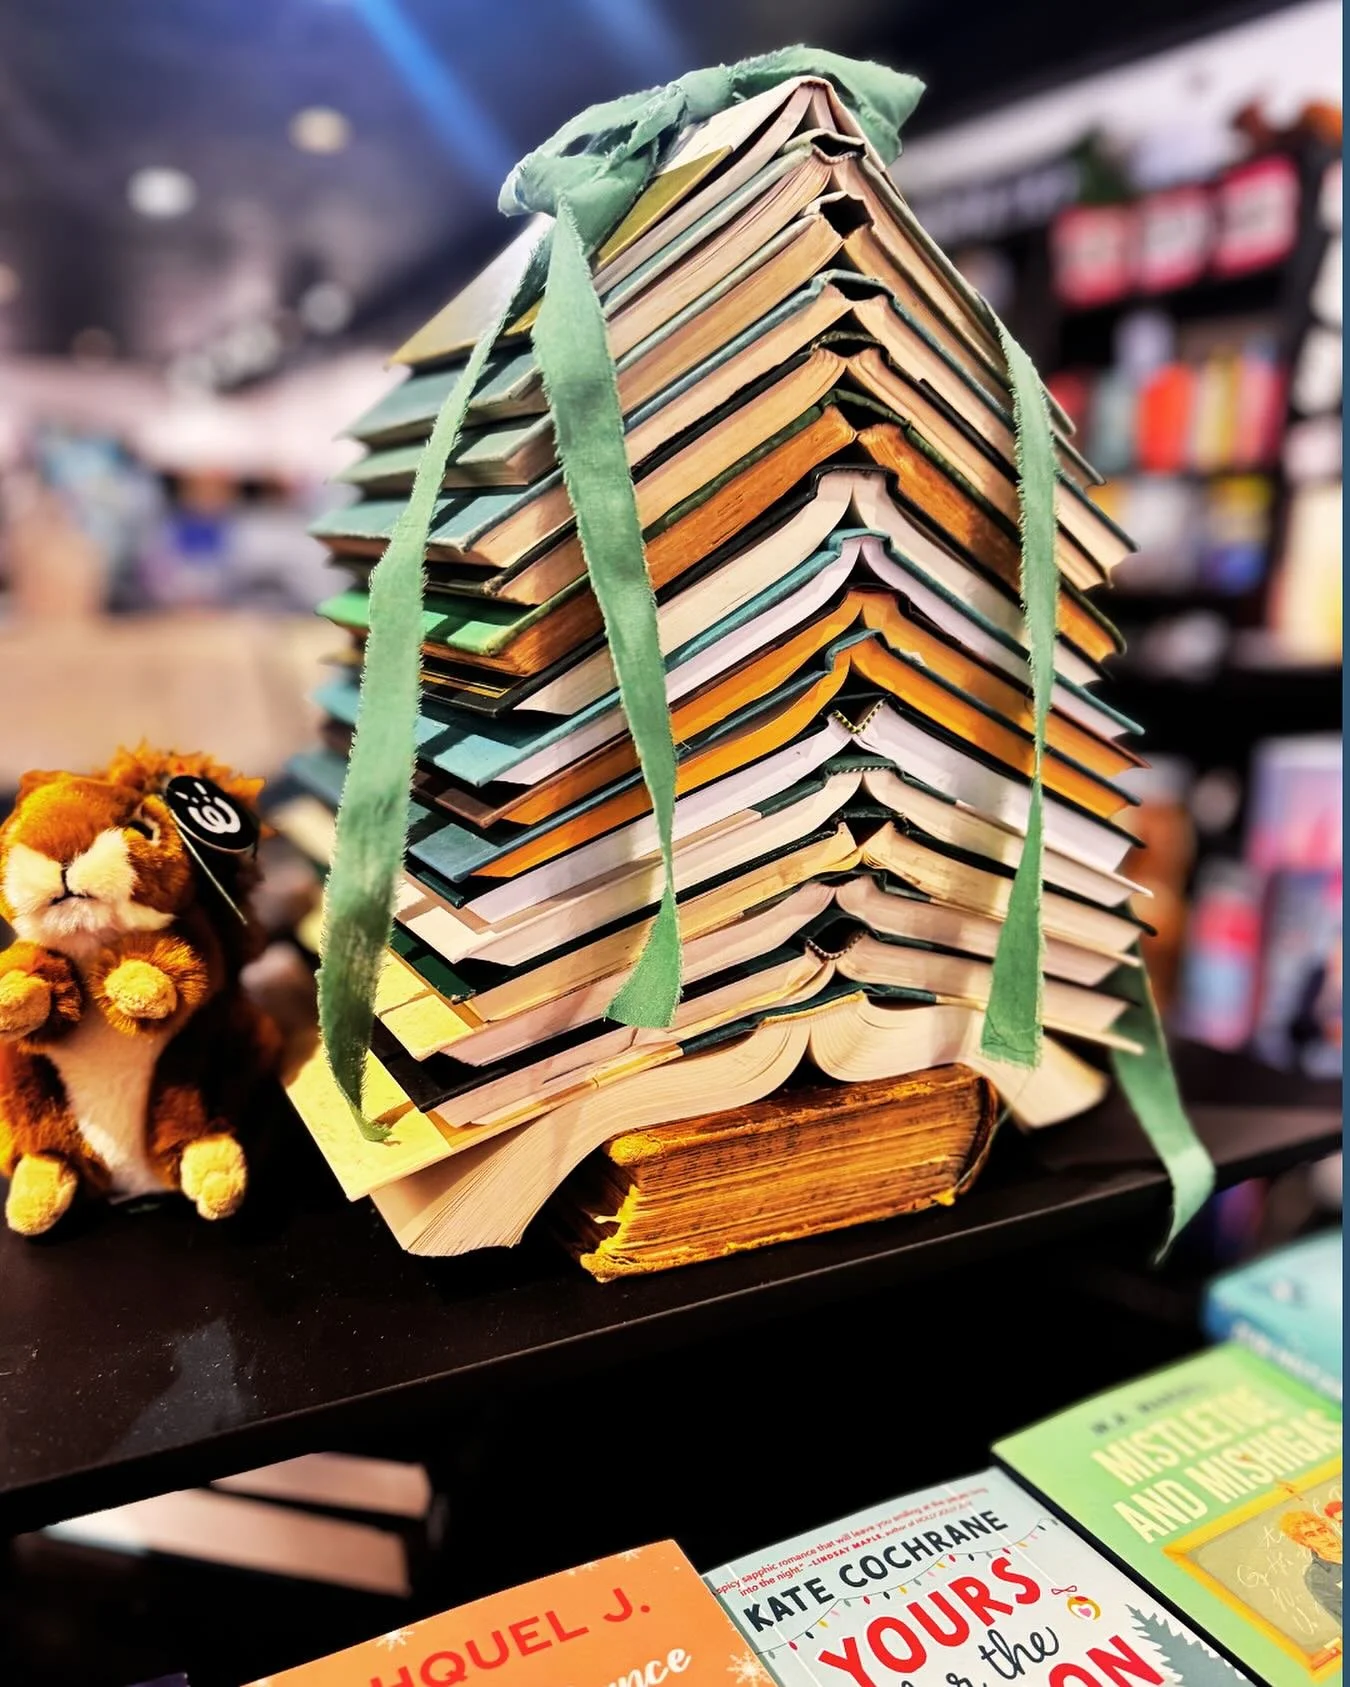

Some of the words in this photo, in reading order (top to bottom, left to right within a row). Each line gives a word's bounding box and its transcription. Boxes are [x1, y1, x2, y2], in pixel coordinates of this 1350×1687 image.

[1113, 1479, 1208, 1543] AND
[742, 1563, 778, 1582] sapphic
[779, 1549, 817, 1567] romance
[817, 1539, 836, 1552] that
[836, 1532, 852, 1544] will
[743, 1577, 835, 1633] KATE
[839, 1510, 1009, 1588] COCHRANE
[603, 1587, 650, 1622] J.
[739, 1583, 759, 1597] into
[759, 1577, 776, 1588] the
[819, 1557, 1040, 1687] YOURS
[978, 1626, 1059, 1680] the
